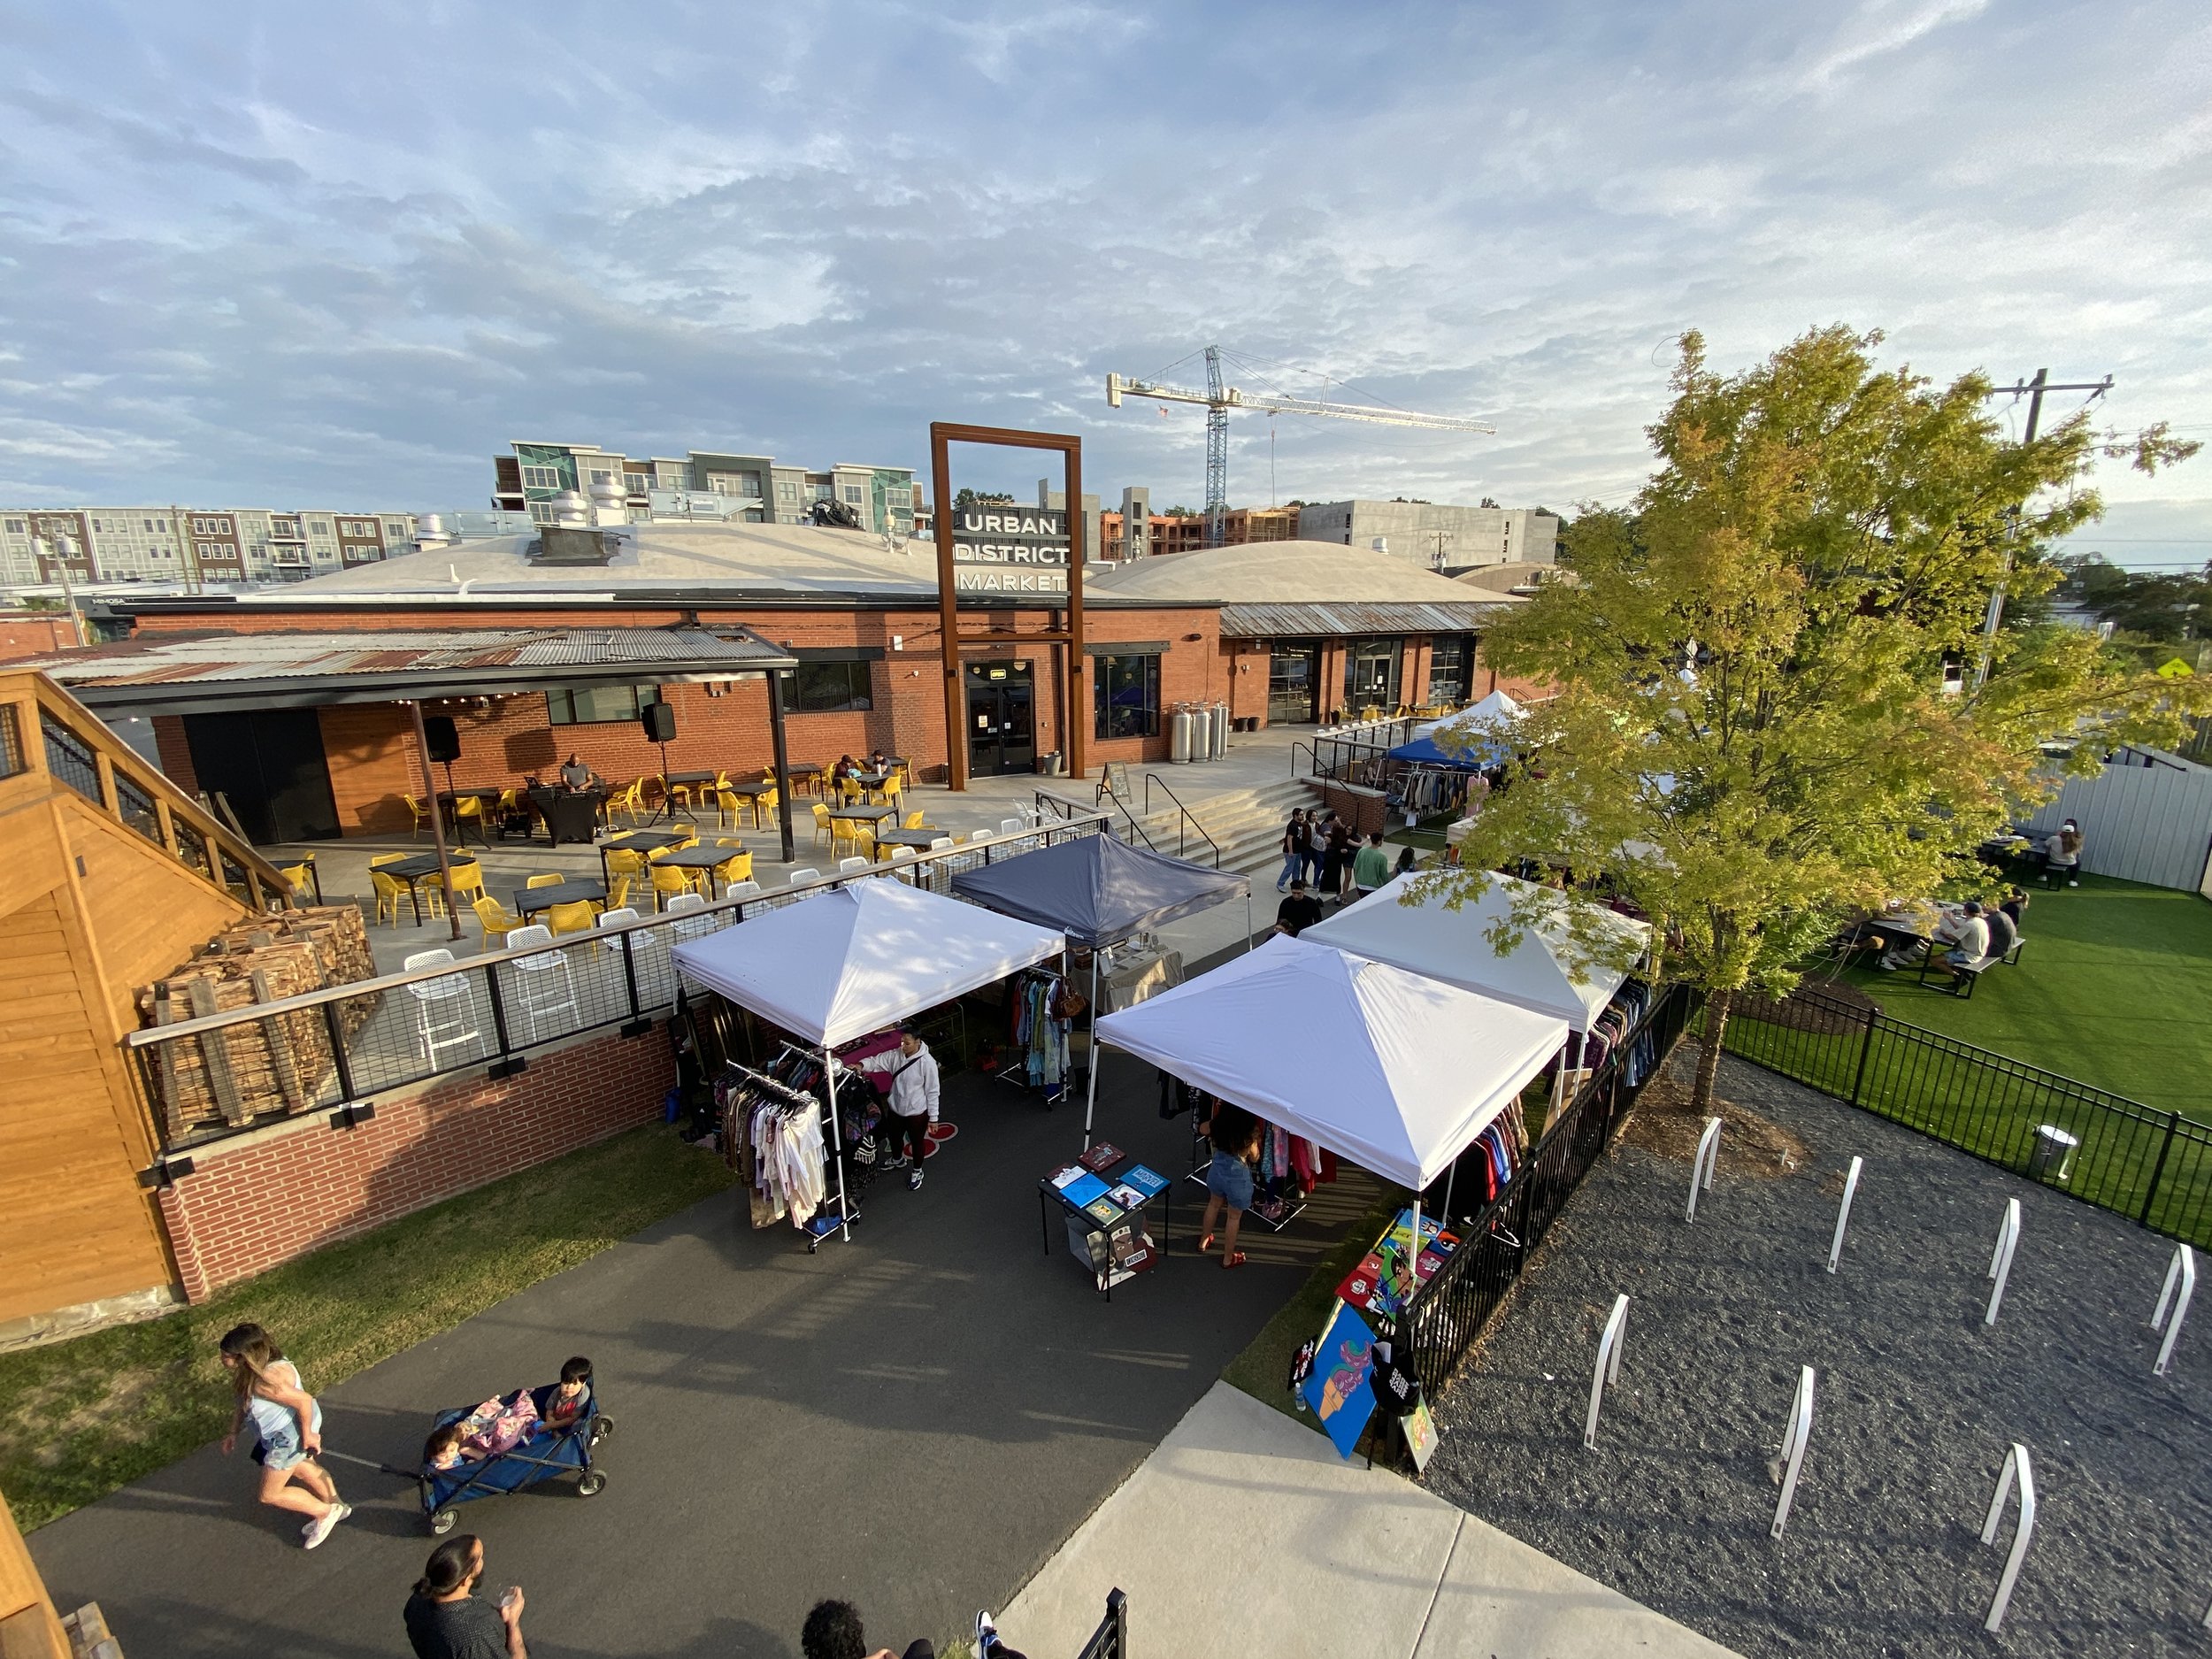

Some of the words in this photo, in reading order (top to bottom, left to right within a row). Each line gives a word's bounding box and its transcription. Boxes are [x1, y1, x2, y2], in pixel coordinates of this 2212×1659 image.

[965, 513, 1057, 535] URBAN
[955, 543, 1070, 564] DISTRICT
[959, 573, 1067, 591] MARKET
[1135, 1170, 1159, 1187] MARVEL
